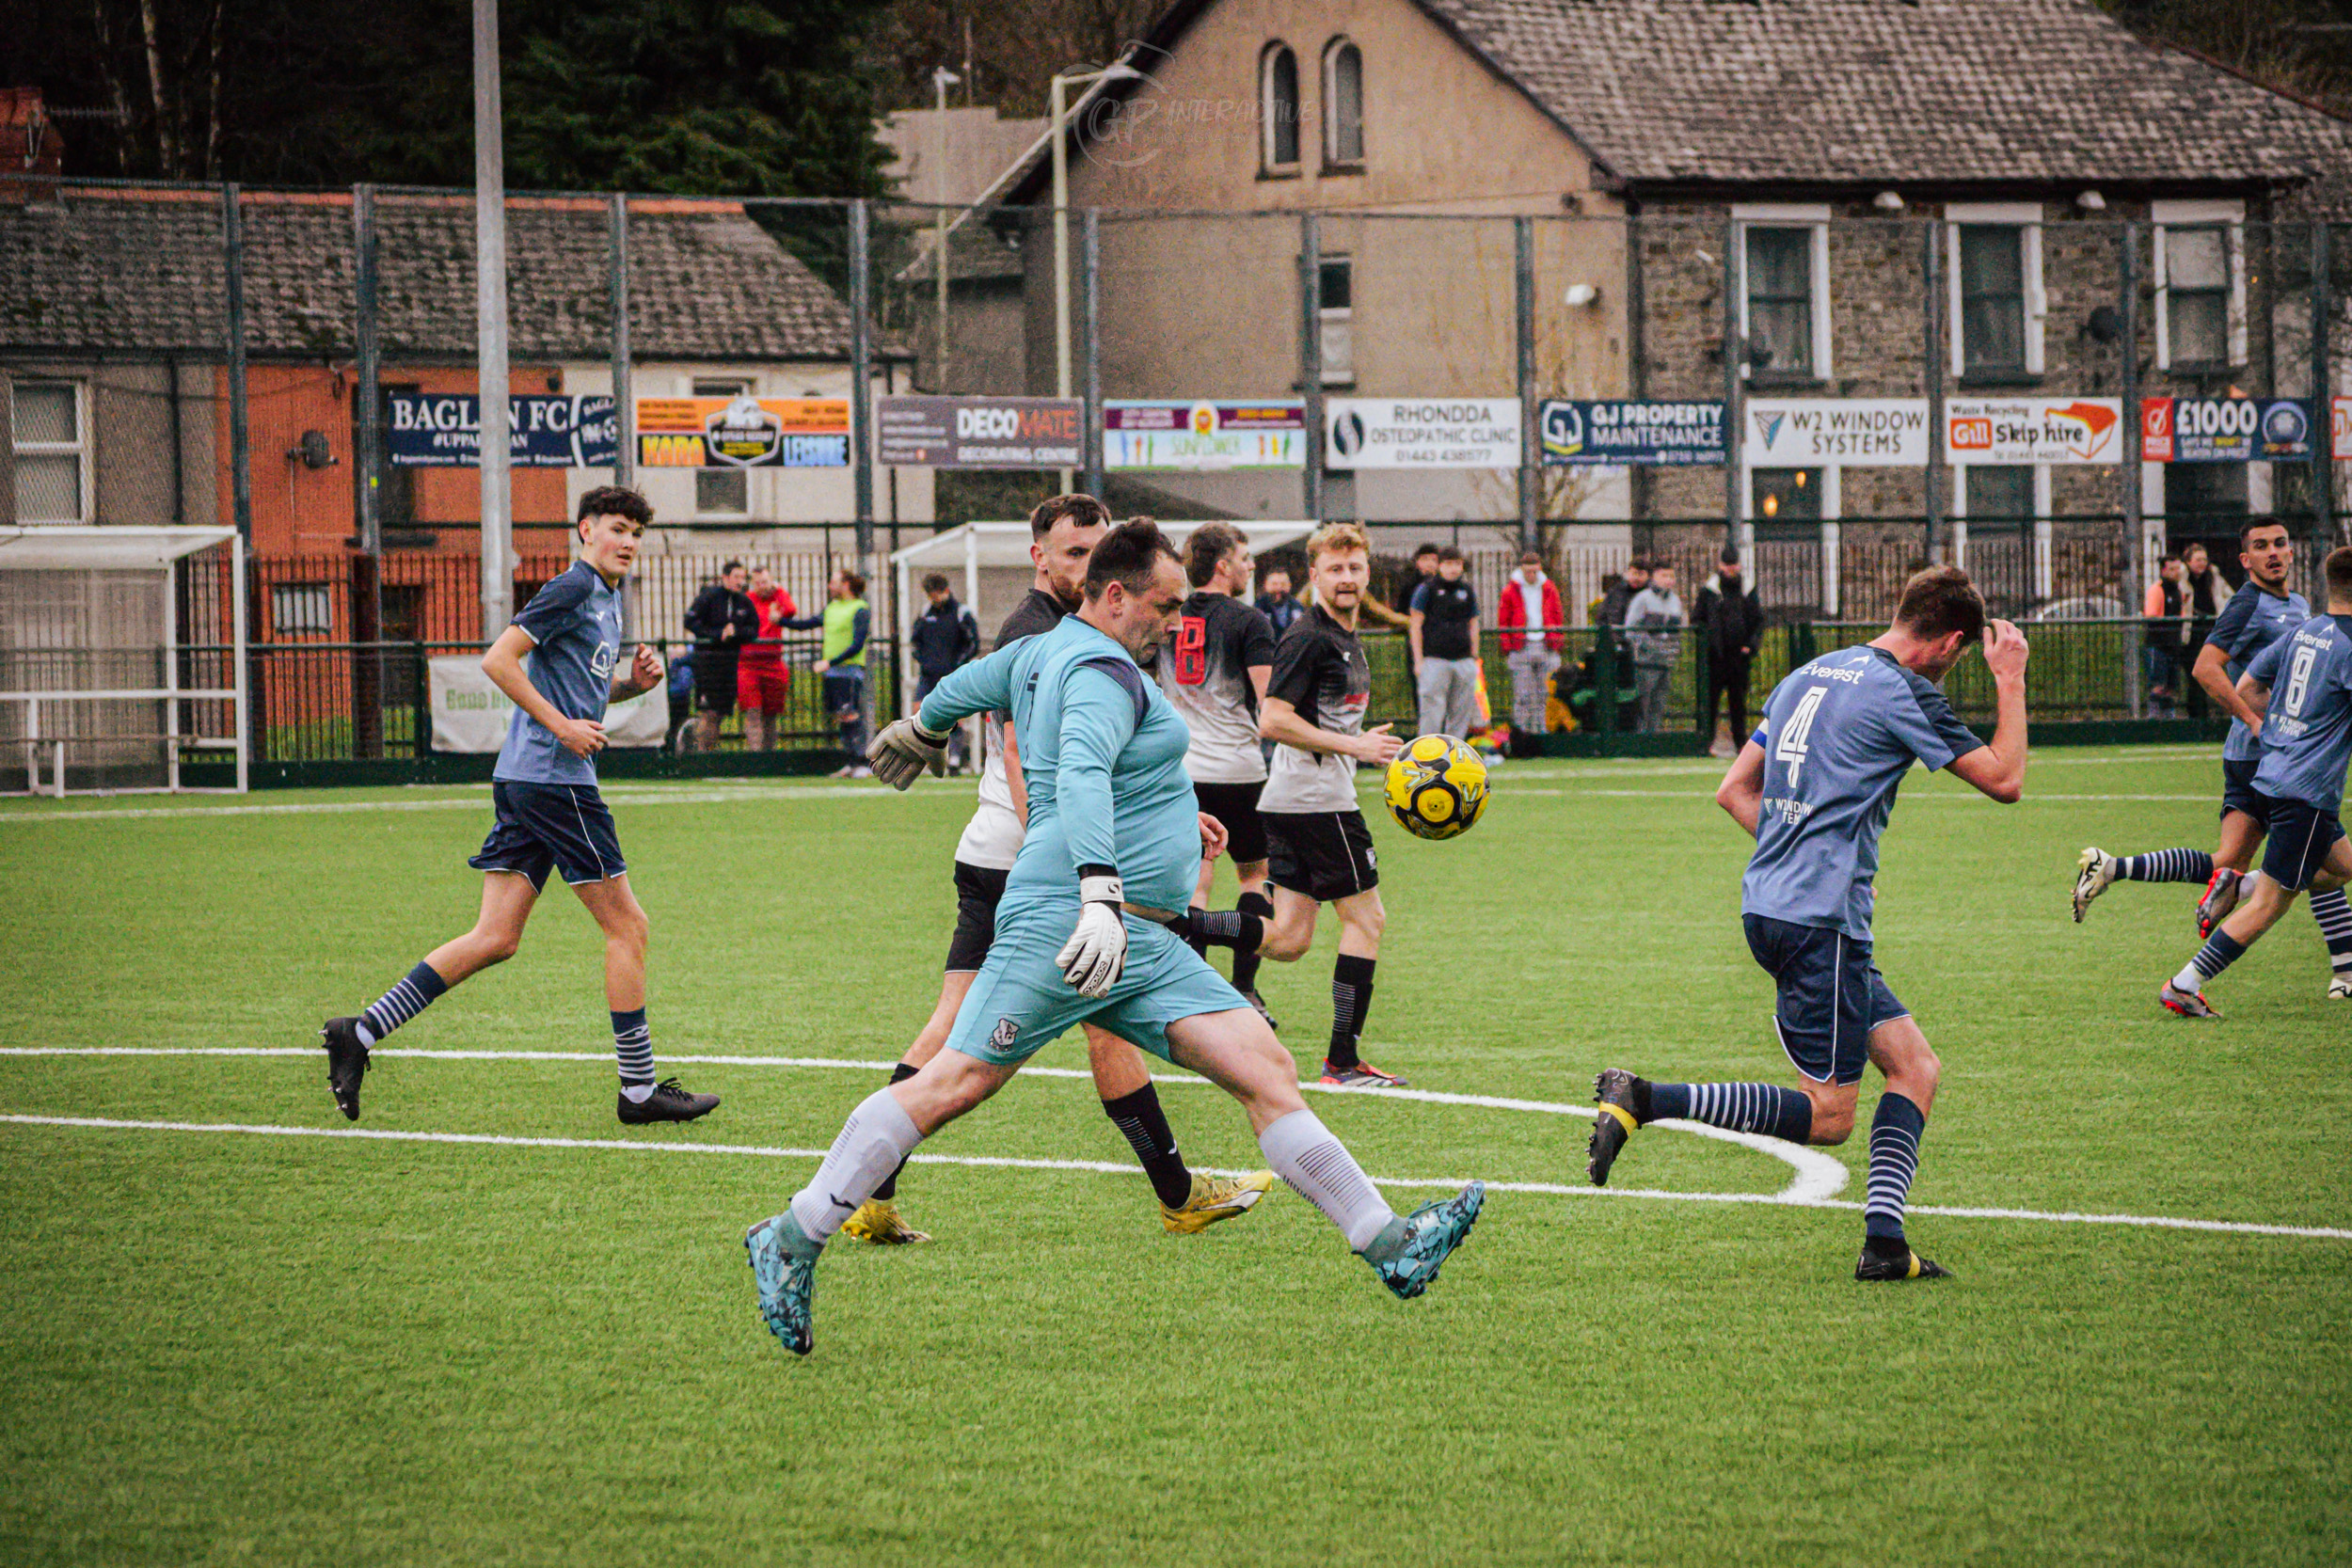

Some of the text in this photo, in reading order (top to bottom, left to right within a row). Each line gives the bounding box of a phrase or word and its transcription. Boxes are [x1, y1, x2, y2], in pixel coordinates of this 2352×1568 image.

[392, 399, 520, 431] BAGLN
[529, 401, 567, 432] FC
[1393, 404, 1492, 422] RHONDDA
[1591, 404, 1724, 426] GJ PROPERTY
[1792, 410, 1925, 431] W2 WINDOW
[1984, 404, 2029, 418] Recycling
[2176, 400, 2258, 436] £1000
[957, 407, 1076, 439] DECOMATE
[1953, 421, 2084, 448] Gill Skip hire
[1371, 428, 1516, 444] OSTEOPATHIC CLINIC
[1591, 426, 1723, 447] MAINTENANCE
[1812, 434, 1901, 454] SYSTEMS
[1176, 615, 1206, 686] 8
[2295, 629, 2333, 651] Everest
[1801, 661, 1865, 685] Everest
[2285, 645, 2316, 718] 8
[1776, 686, 1829, 788] 4
